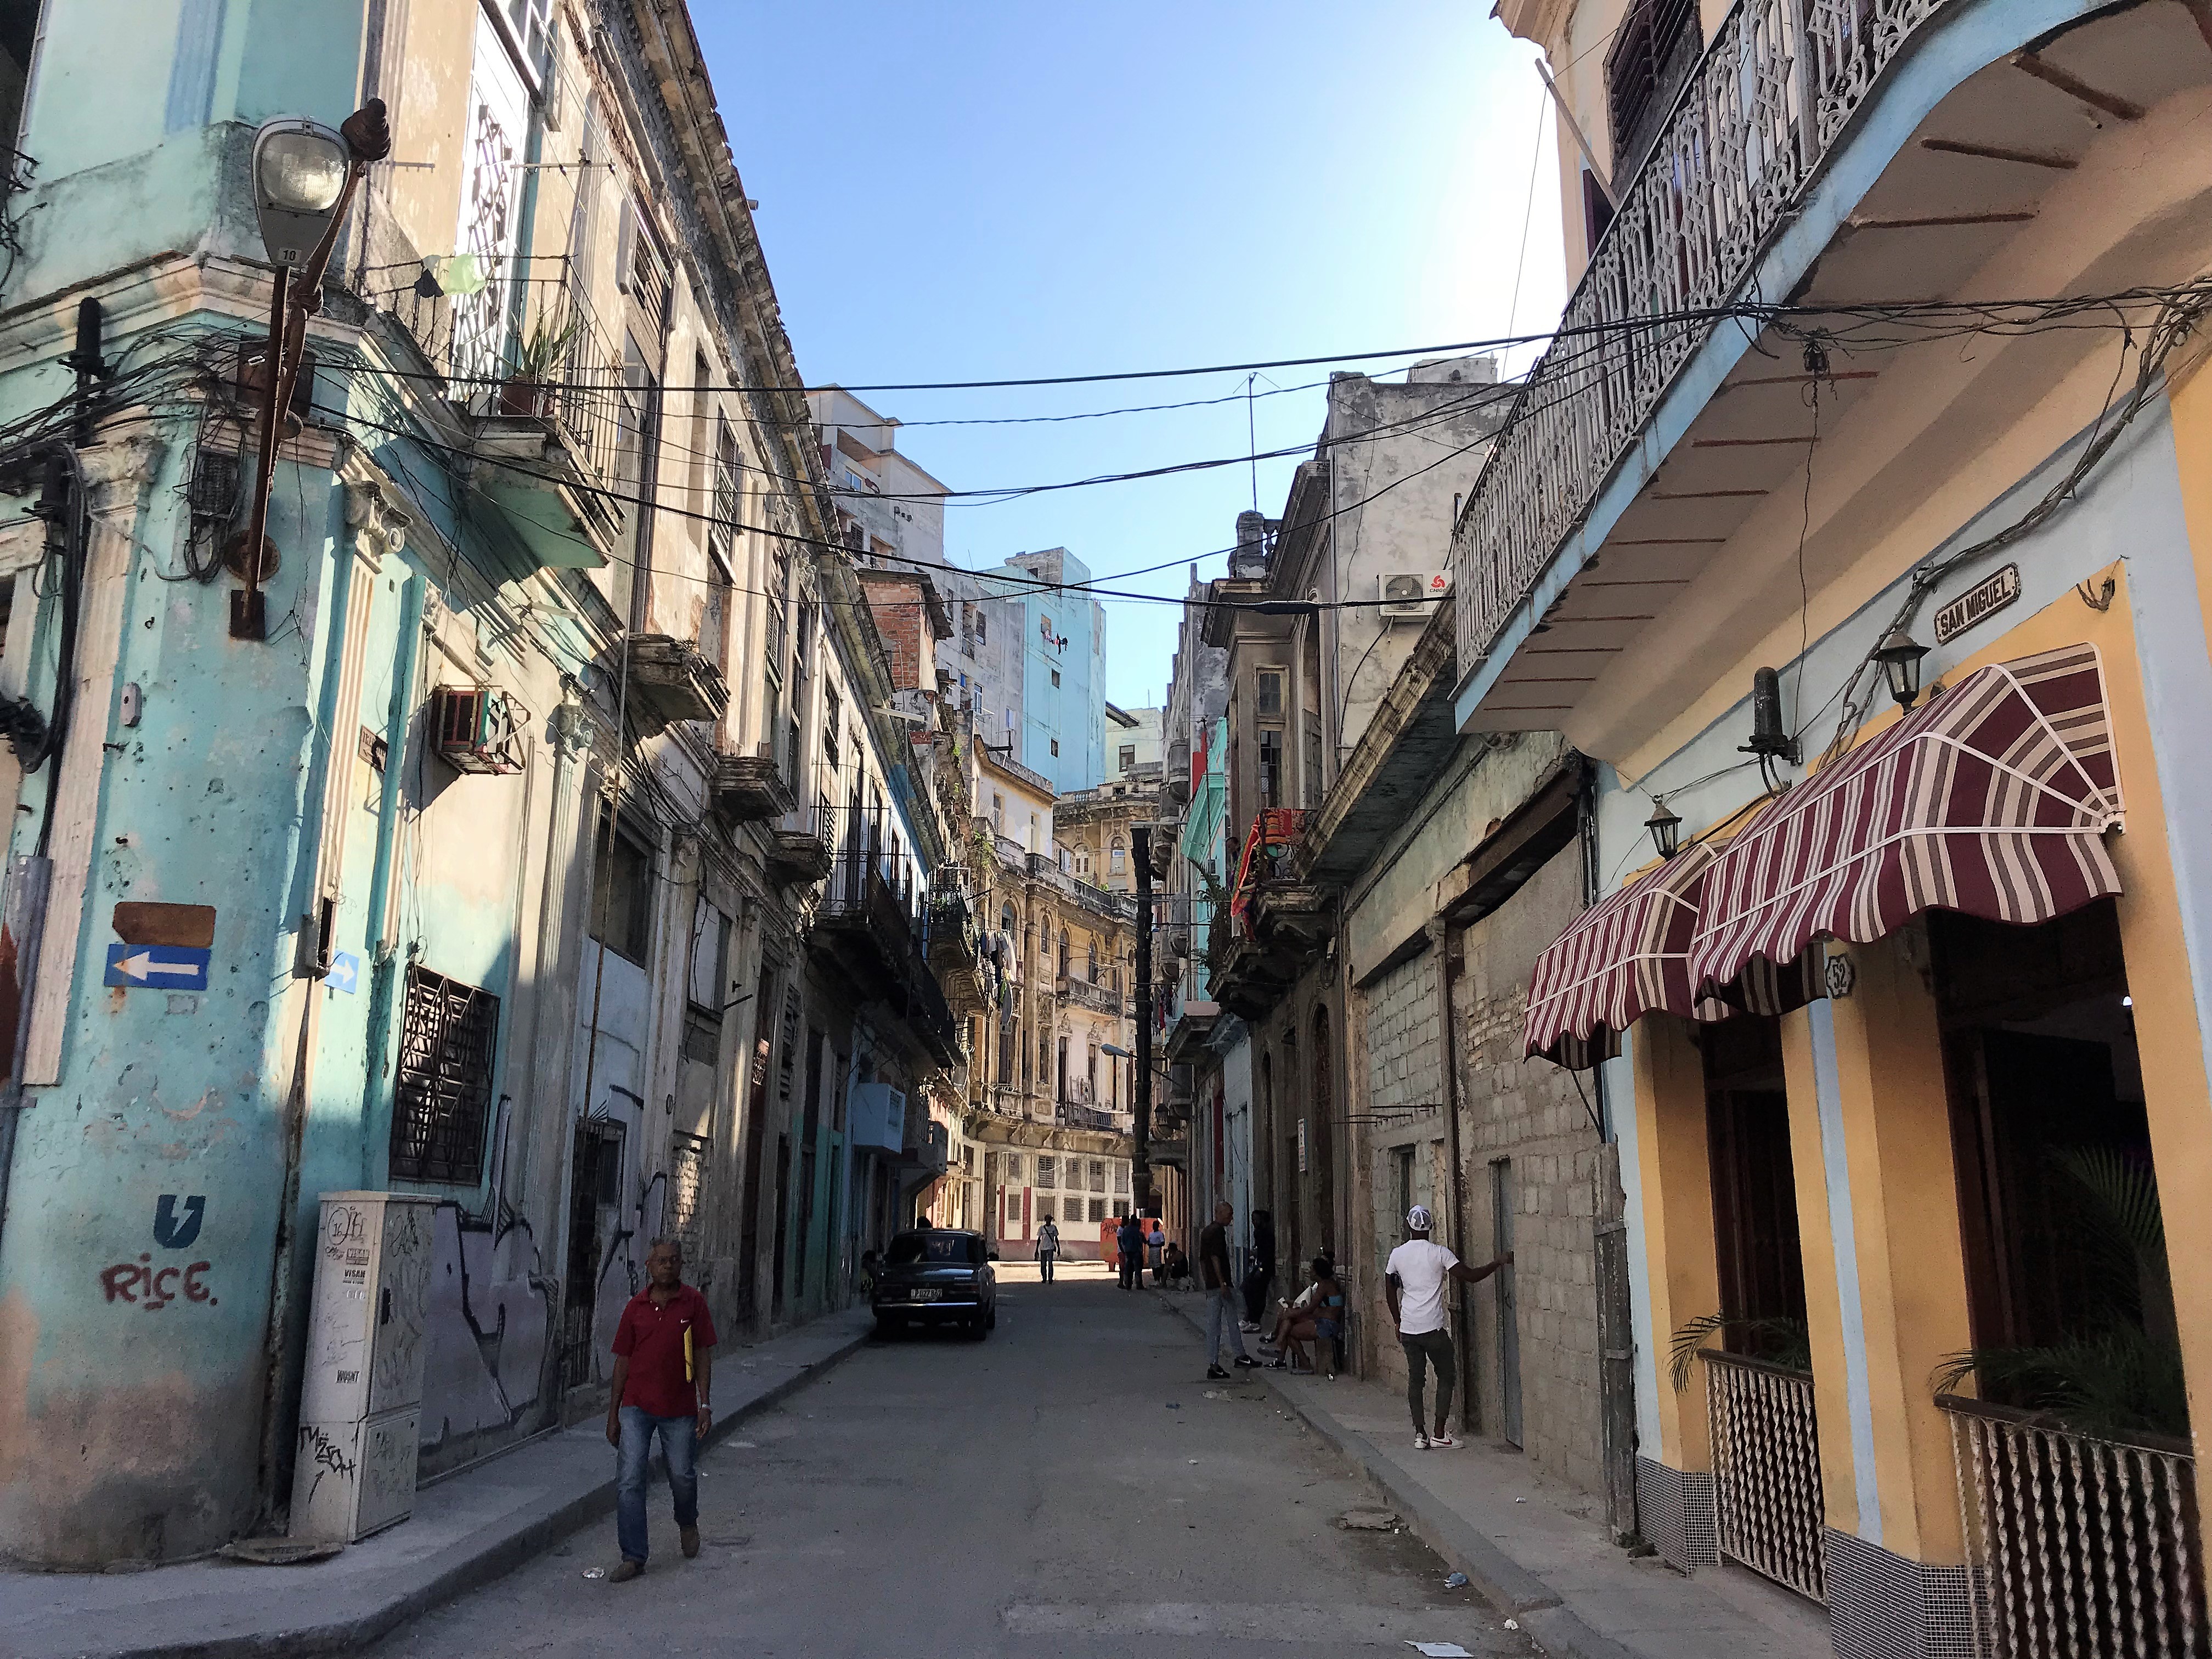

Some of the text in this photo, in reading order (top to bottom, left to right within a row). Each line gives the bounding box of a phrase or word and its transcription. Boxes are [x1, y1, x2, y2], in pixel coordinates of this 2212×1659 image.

[283, 250, 296, 261] 10
[1940, 575, 2012, 636] SAN MIGUEL
[1833, 963, 1846, 988] 52
